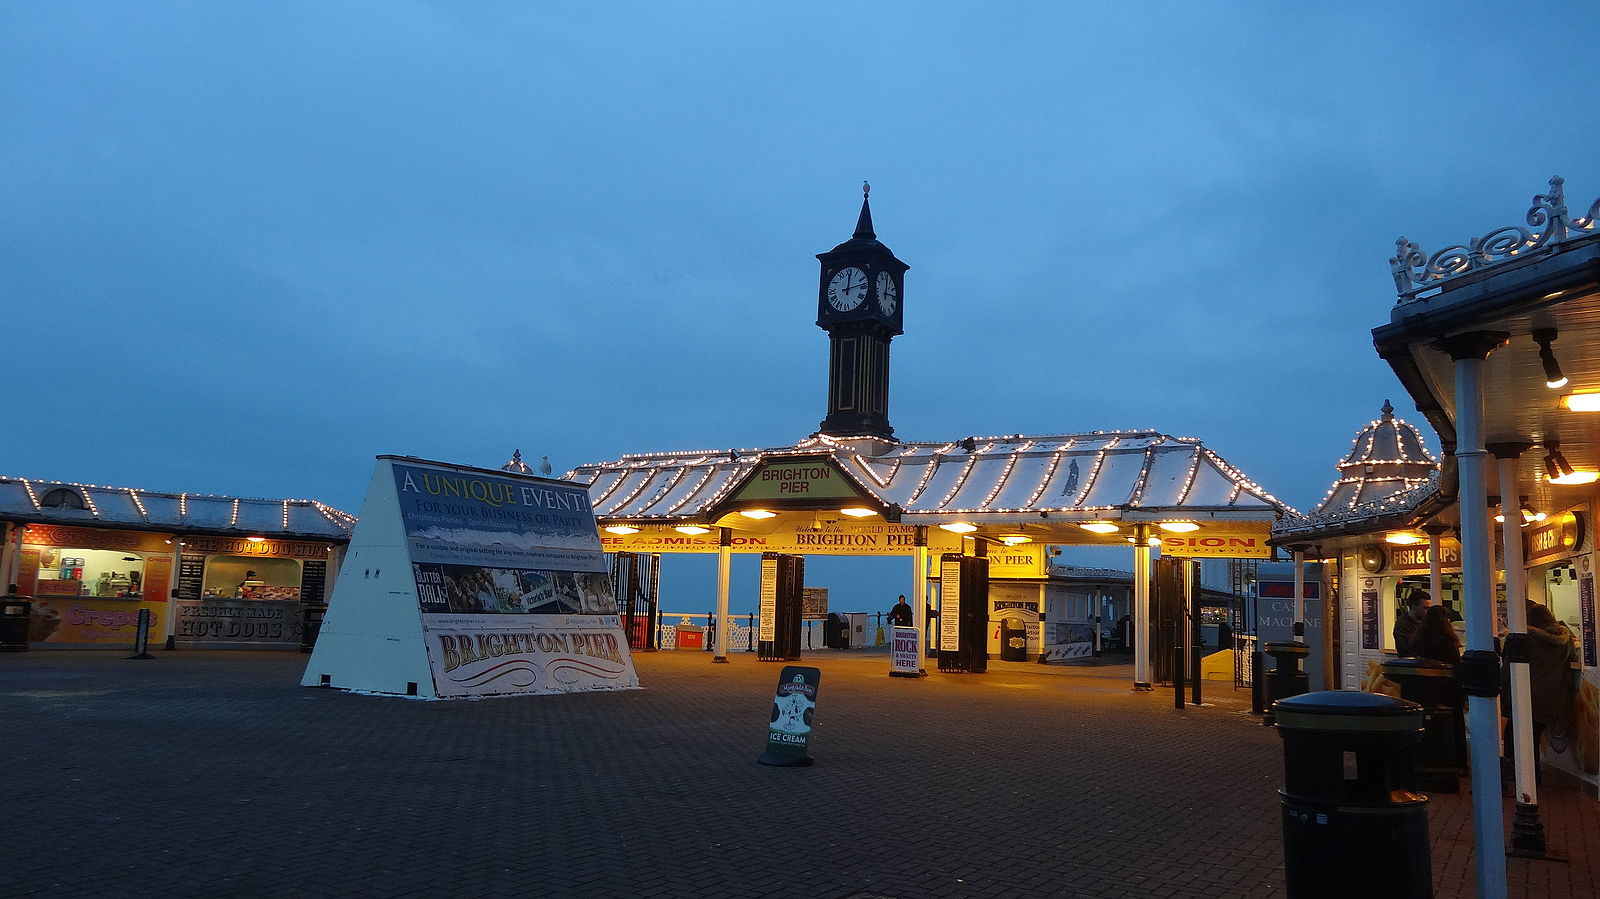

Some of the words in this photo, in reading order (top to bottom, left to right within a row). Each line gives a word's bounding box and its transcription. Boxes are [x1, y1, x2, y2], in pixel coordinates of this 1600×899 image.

[762, 468, 830, 481] BRIGHTON
[401, 470, 420, 493] A
[422, 474, 517, 507] UNIQUE
[520, 486, 588, 512] EVENT!
[780, 481, 809, 493] PIER
[482, 506, 533, 522] BUSINESS
[553, 514, 583, 528] PARTY
[888, 525, 914, 533] FAMO
[632, 537, 767, 545] ADMISSON
[796, 534, 878, 546] BRIGHTON
[886, 534, 914, 546] PIE
[1164, 537, 1256, 547] SION
[222, 541, 256, 554] HOT
[258, 542, 291, 556] DOG
[1005, 555, 1033, 564] PIER
[1393, 550, 1415, 565] FISH
[1416, 549, 1425, 564] &
[1426, 547, 1458, 564] CIPS
[416, 570, 441, 584] GLITTER
[418, 583, 446, 603] BALL
[246, 607, 284, 619] MADE
[1272, 602, 1308, 612] CAS
[1260, 616, 1321, 629] MACNE
[178, 620, 222, 637] HOT
[225, 622, 282, 638] DOGS
[896, 631, 917, 639] BRIGHTON
[895, 639, 918, 653] ROCK
[438, 632, 568, 674] BRIGHTON
[571, 632, 626, 666] PIER
[896, 659, 916, 667] HERE
[769, 732, 781, 741] ICE
[782, 733, 806, 744] CREAM
